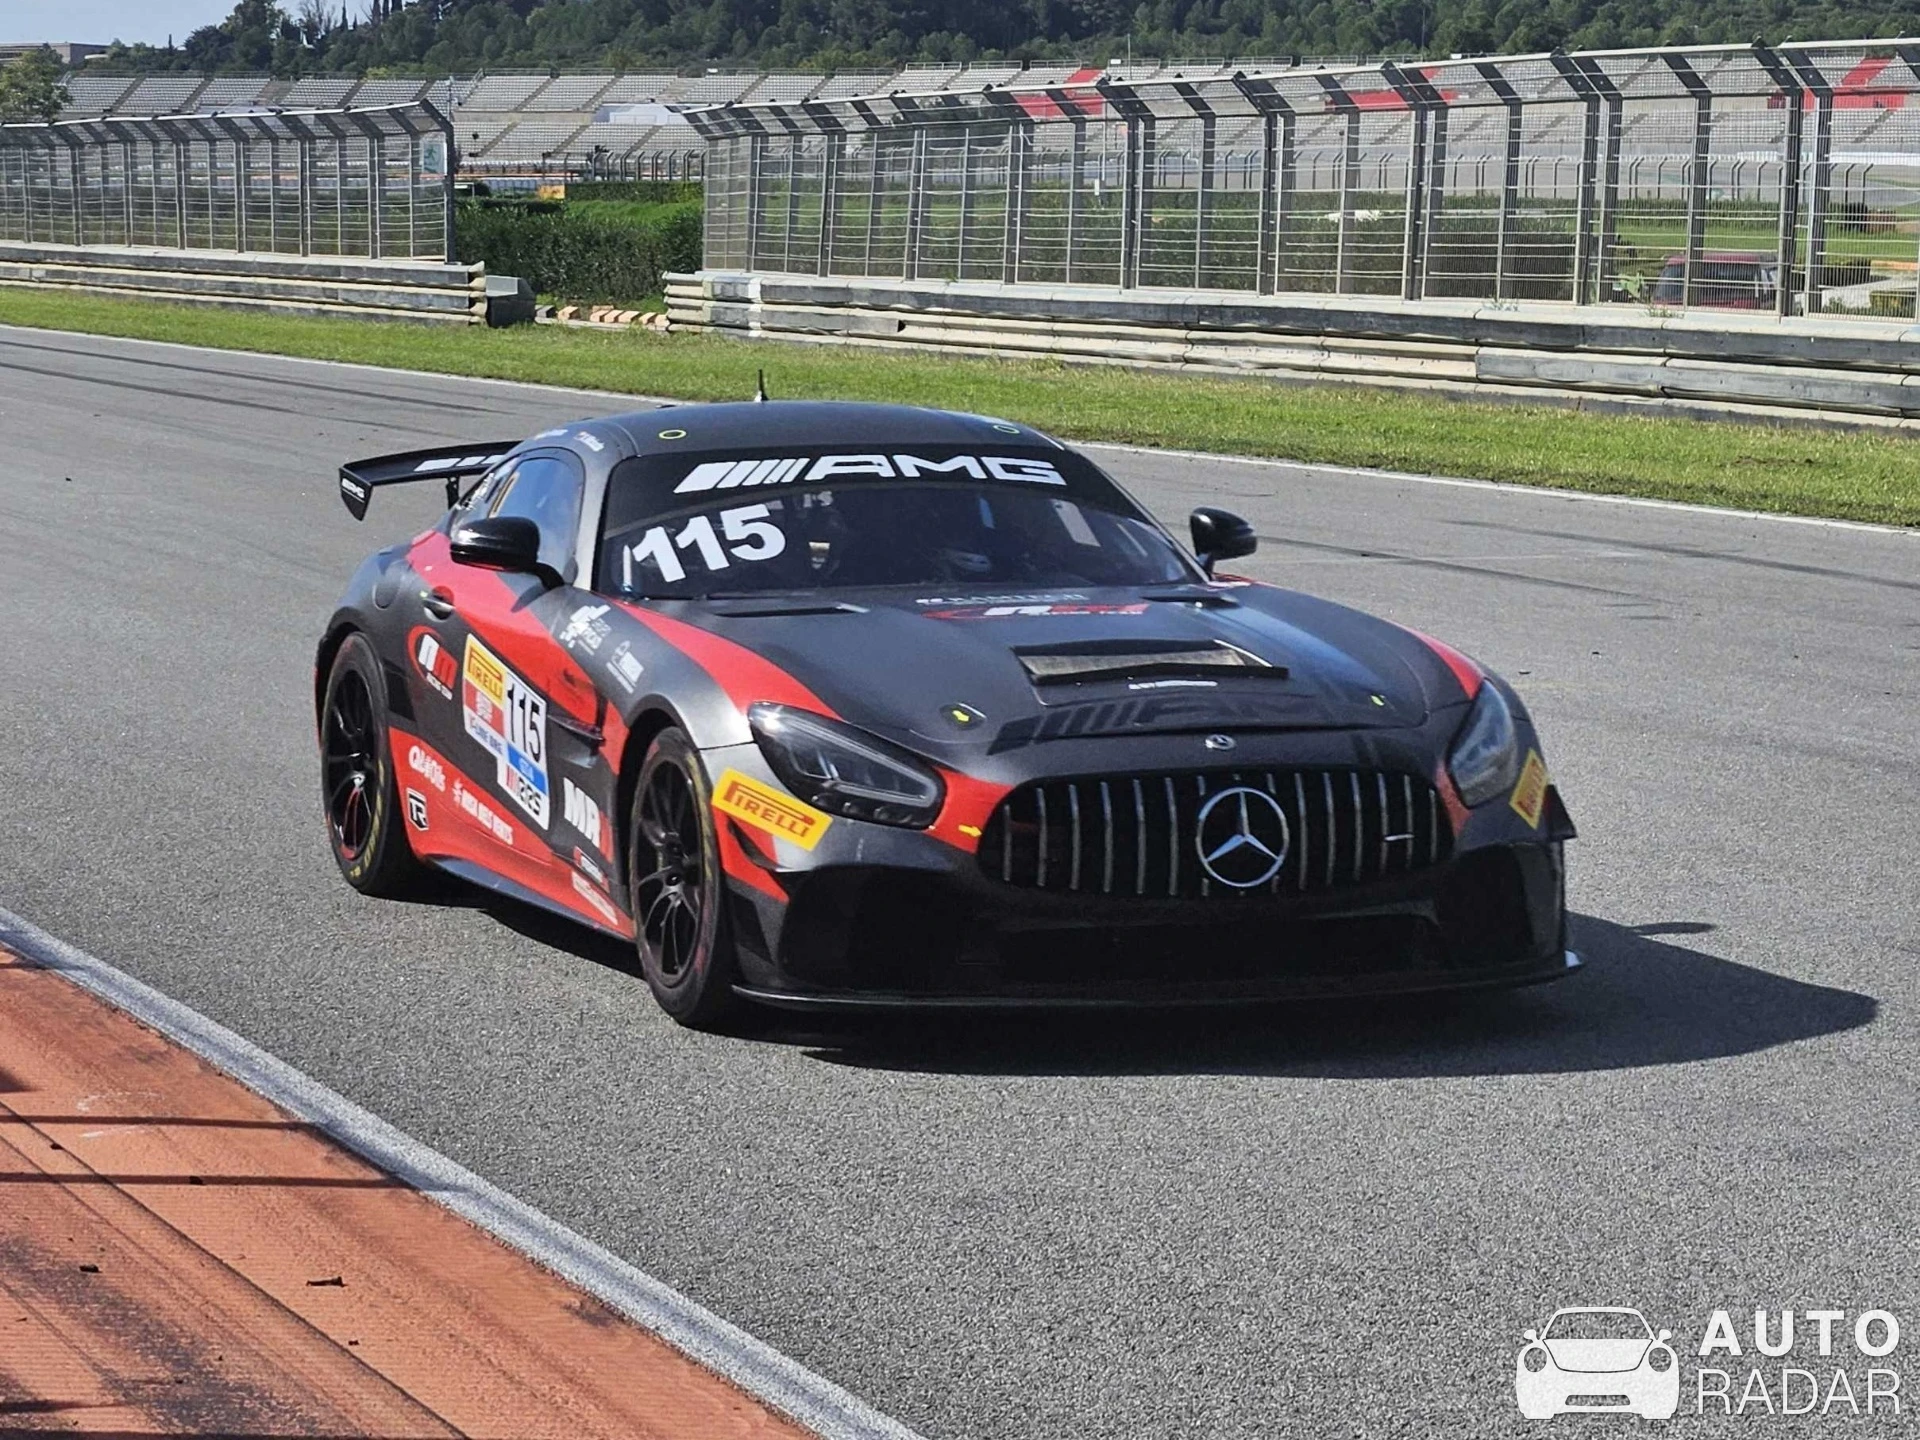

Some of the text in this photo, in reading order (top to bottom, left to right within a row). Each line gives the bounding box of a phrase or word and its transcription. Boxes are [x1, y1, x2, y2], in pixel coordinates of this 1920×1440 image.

[805, 454, 1067, 486] AMG
[632, 504, 786, 583] 115
[468, 646, 503, 701] PIRELLI
[507, 683, 541, 763] 115
[723, 780, 816, 838] PIRELLI
